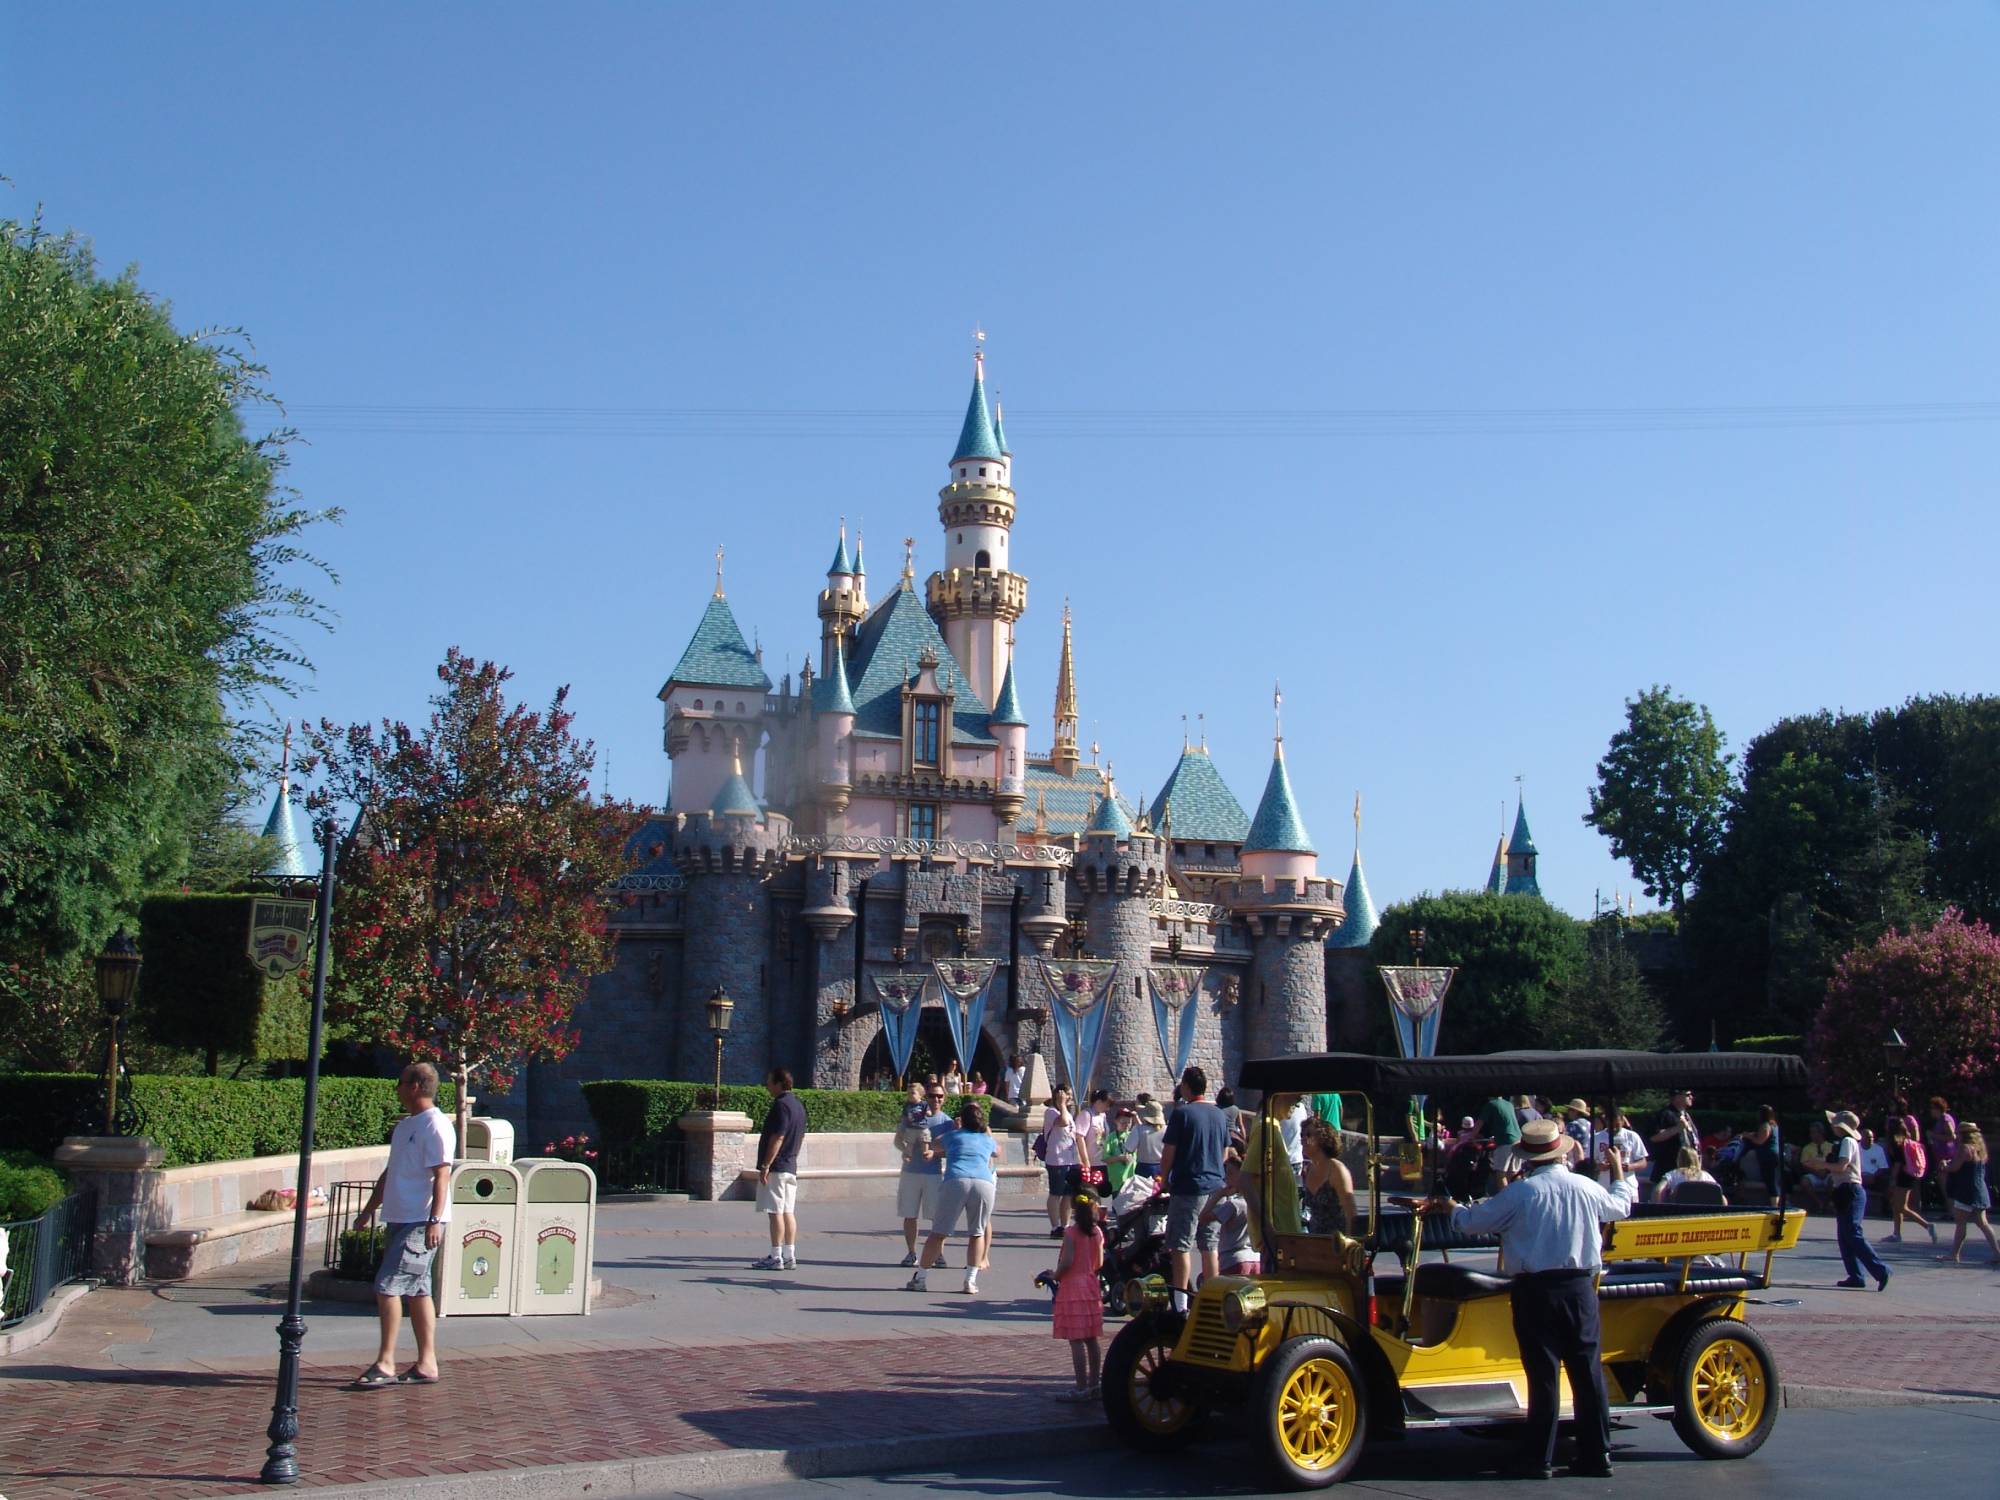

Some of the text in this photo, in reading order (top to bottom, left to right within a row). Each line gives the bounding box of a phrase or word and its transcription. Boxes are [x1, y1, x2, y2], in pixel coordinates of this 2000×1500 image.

[1635, 1227, 1751, 1246] DISNEYLAND TRANSPORTATION CO.
